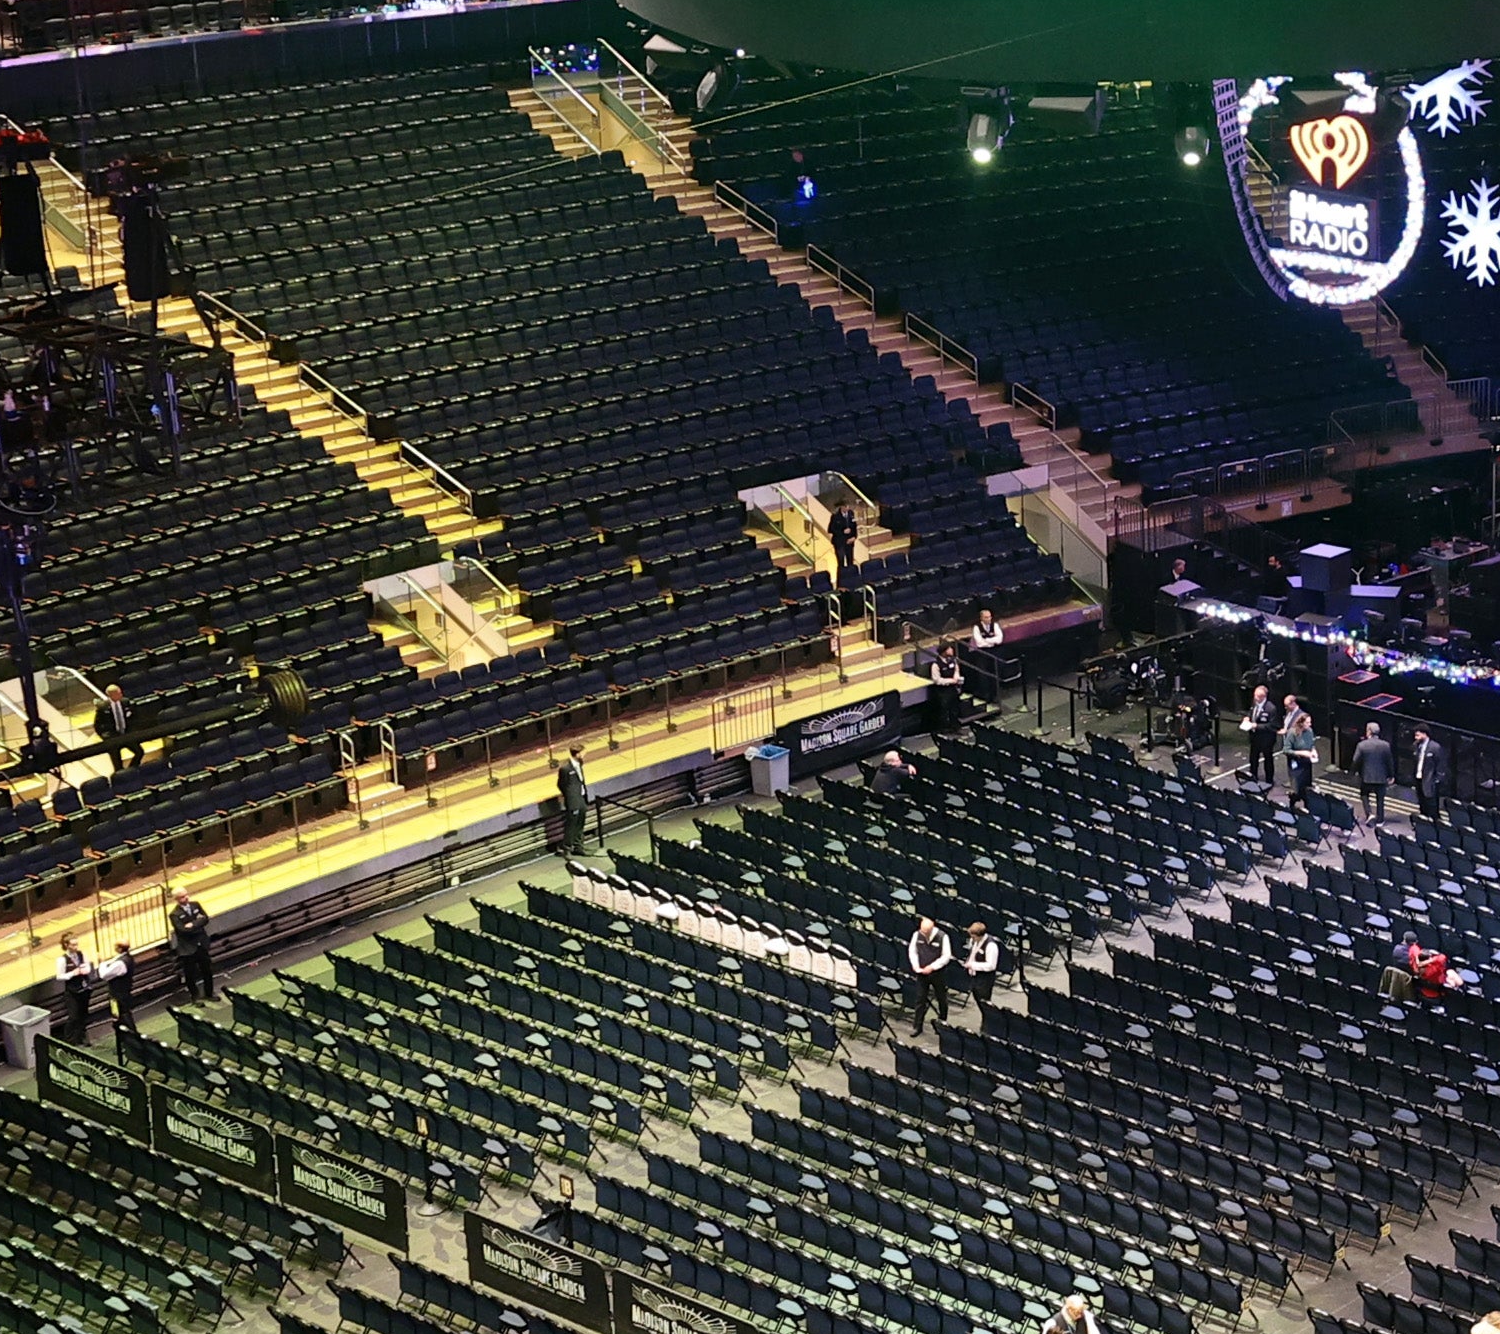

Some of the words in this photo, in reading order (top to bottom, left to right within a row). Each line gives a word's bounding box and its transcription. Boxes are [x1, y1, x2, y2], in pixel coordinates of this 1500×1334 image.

[1288, 219, 1369, 257] RADIO
[293, 1164, 328, 1195] MADISON
[327, 1178, 357, 1206] SQUARE
[356, 1190, 388, 1218] GARDEN
[483, 1243, 521, 1276] MADISON
[520, 1259, 553, 1289] SQUARE
[552, 1272, 587, 1302] GARDEN
